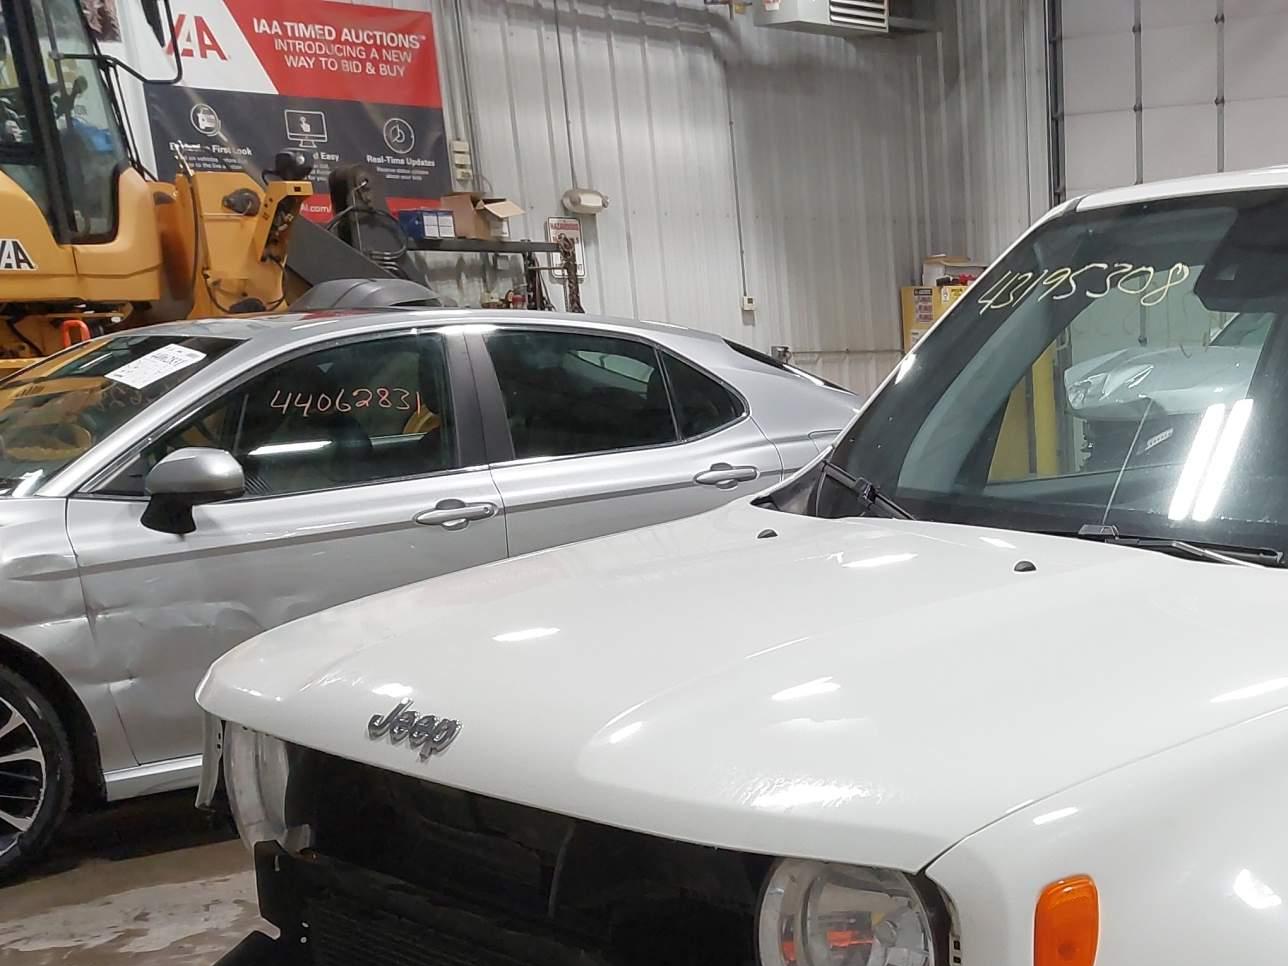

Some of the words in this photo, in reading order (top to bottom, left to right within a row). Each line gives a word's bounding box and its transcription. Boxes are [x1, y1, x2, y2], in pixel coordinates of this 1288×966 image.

[253, 17, 283, 35] IAA
[283, 21, 336, 41] TIMED
[274, 38, 366, 59] INTRODUCING
[369, 50, 380, 59] A
[382, 49, 413, 63] NEW
[284, 55, 316, 68] WAY
[319, 57, 338, 71] TO
[341, 61, 362, 73] BID
[365, 63, 376, 75] &
[379, 64, 406, 77] BUY
[977, 262, 1190, 316] 43195308
[270, 388, 421, 417] 44062831
[367, 698, 460, 762] Jeep
